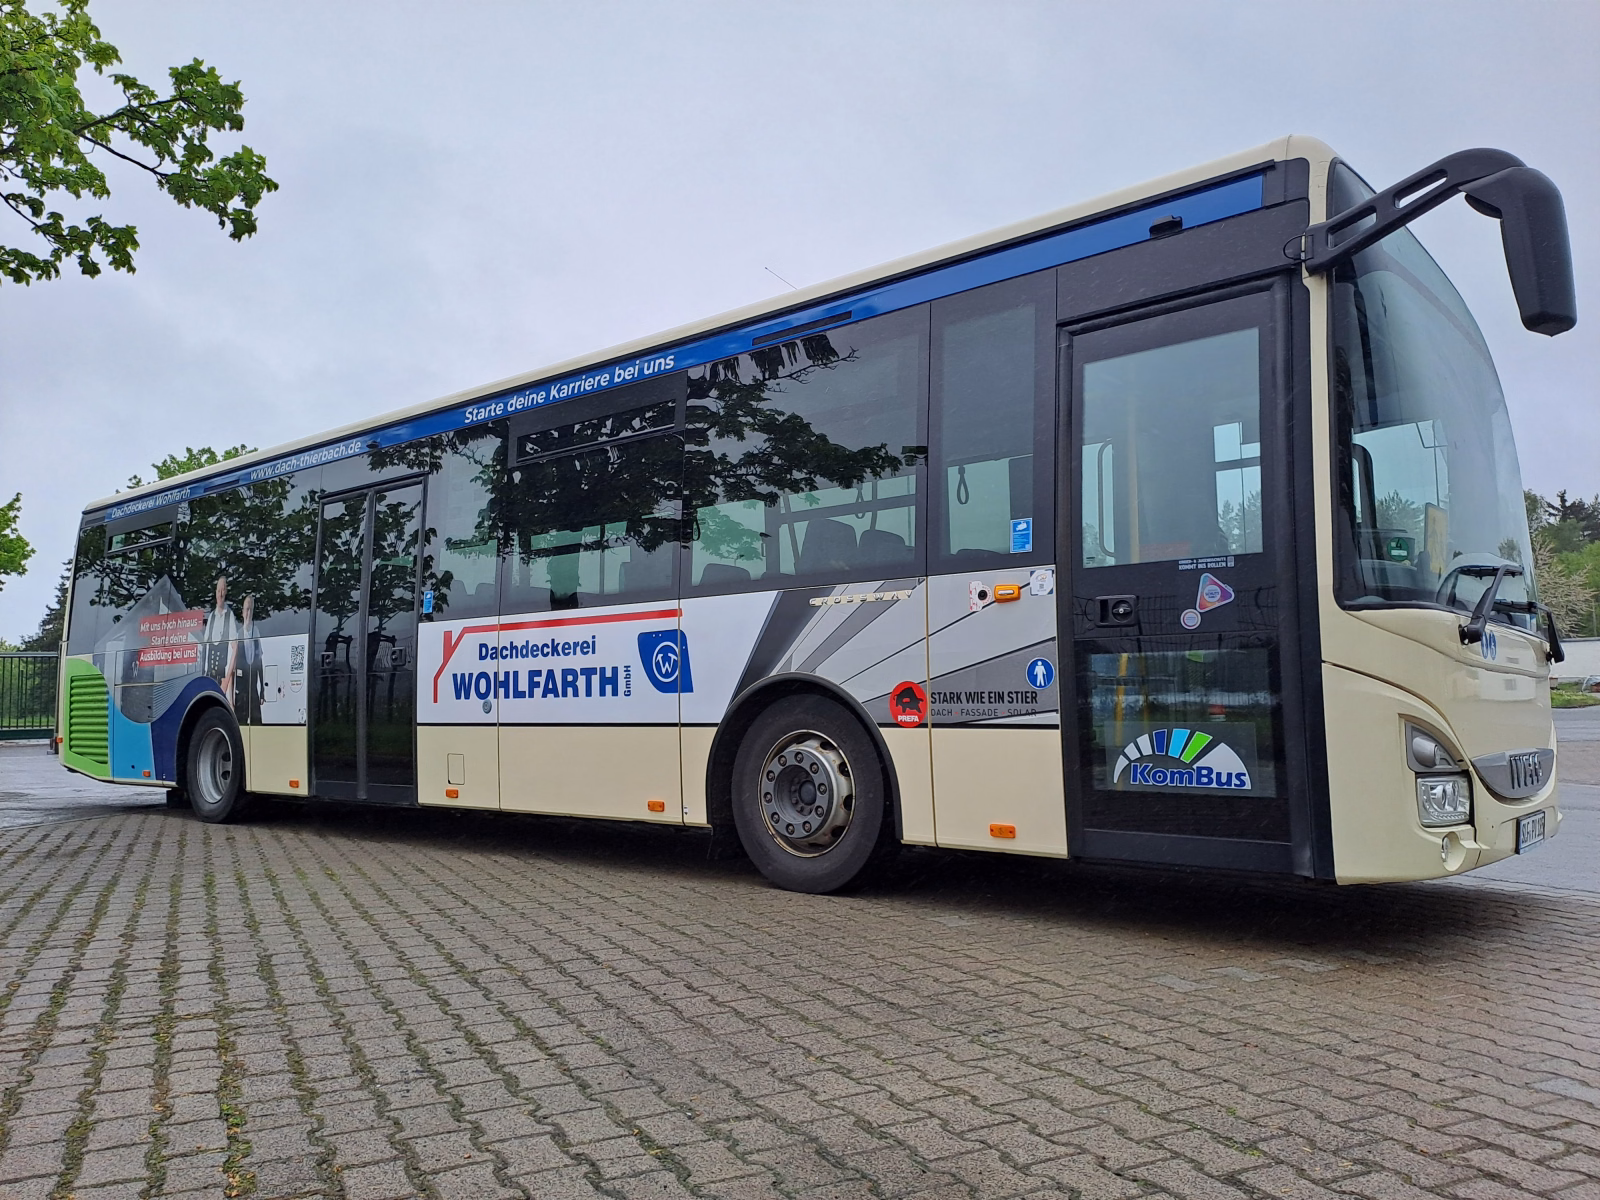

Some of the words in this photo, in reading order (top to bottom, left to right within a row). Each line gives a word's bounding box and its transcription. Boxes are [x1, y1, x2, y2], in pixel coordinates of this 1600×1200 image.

[464, 402, 503, 423] Starte
[507, 391, 546, 412] deine
[550, 373, 609, 400] Karriere
[614, 361, 639, 383] bei
[643, 355, 675, 375] uns
[250, 440, 361, 480] www.dach-thierbach.de
[111, 499, 155, 519] Dachdeckerei
[156, 488, 191, 506] Wohlfarth
[809, 590, 913, 606] CROSSWAY
[140, 621, 149, 632] Mit
[150, 623, 160, 631] uns
[162, 619, 176, 630] hoch
[177, 618, 198, 629] hinaus
[151, 635, 168, 645] Starte
[169, 632, 187, 643] deine
[140, 650, 172, 662] Ausbildung
[173, 648, 183, 659] bei
[183, 646, 197, 658] uns!
[478, 635, 596, 661] Dachdeckerei
[452, 666, 619, 700] WOHLFARTH
[623, 665, 632, 697] GmbH
[930, 691, 962, 705] STARK
[964, 691, 986, 704] WIE
[988, 691, 1005, 704] EIN
[1007, 690, 1038, 704] STIER
[897, 715, 919, 723] PREFA
[931, 708, 953, 717] DACH
[960, 708, 998, 717] FASSADE
[1007, 708, 1037, 717] SOLAR
[1131, 763, 1247, 788] KomBus
